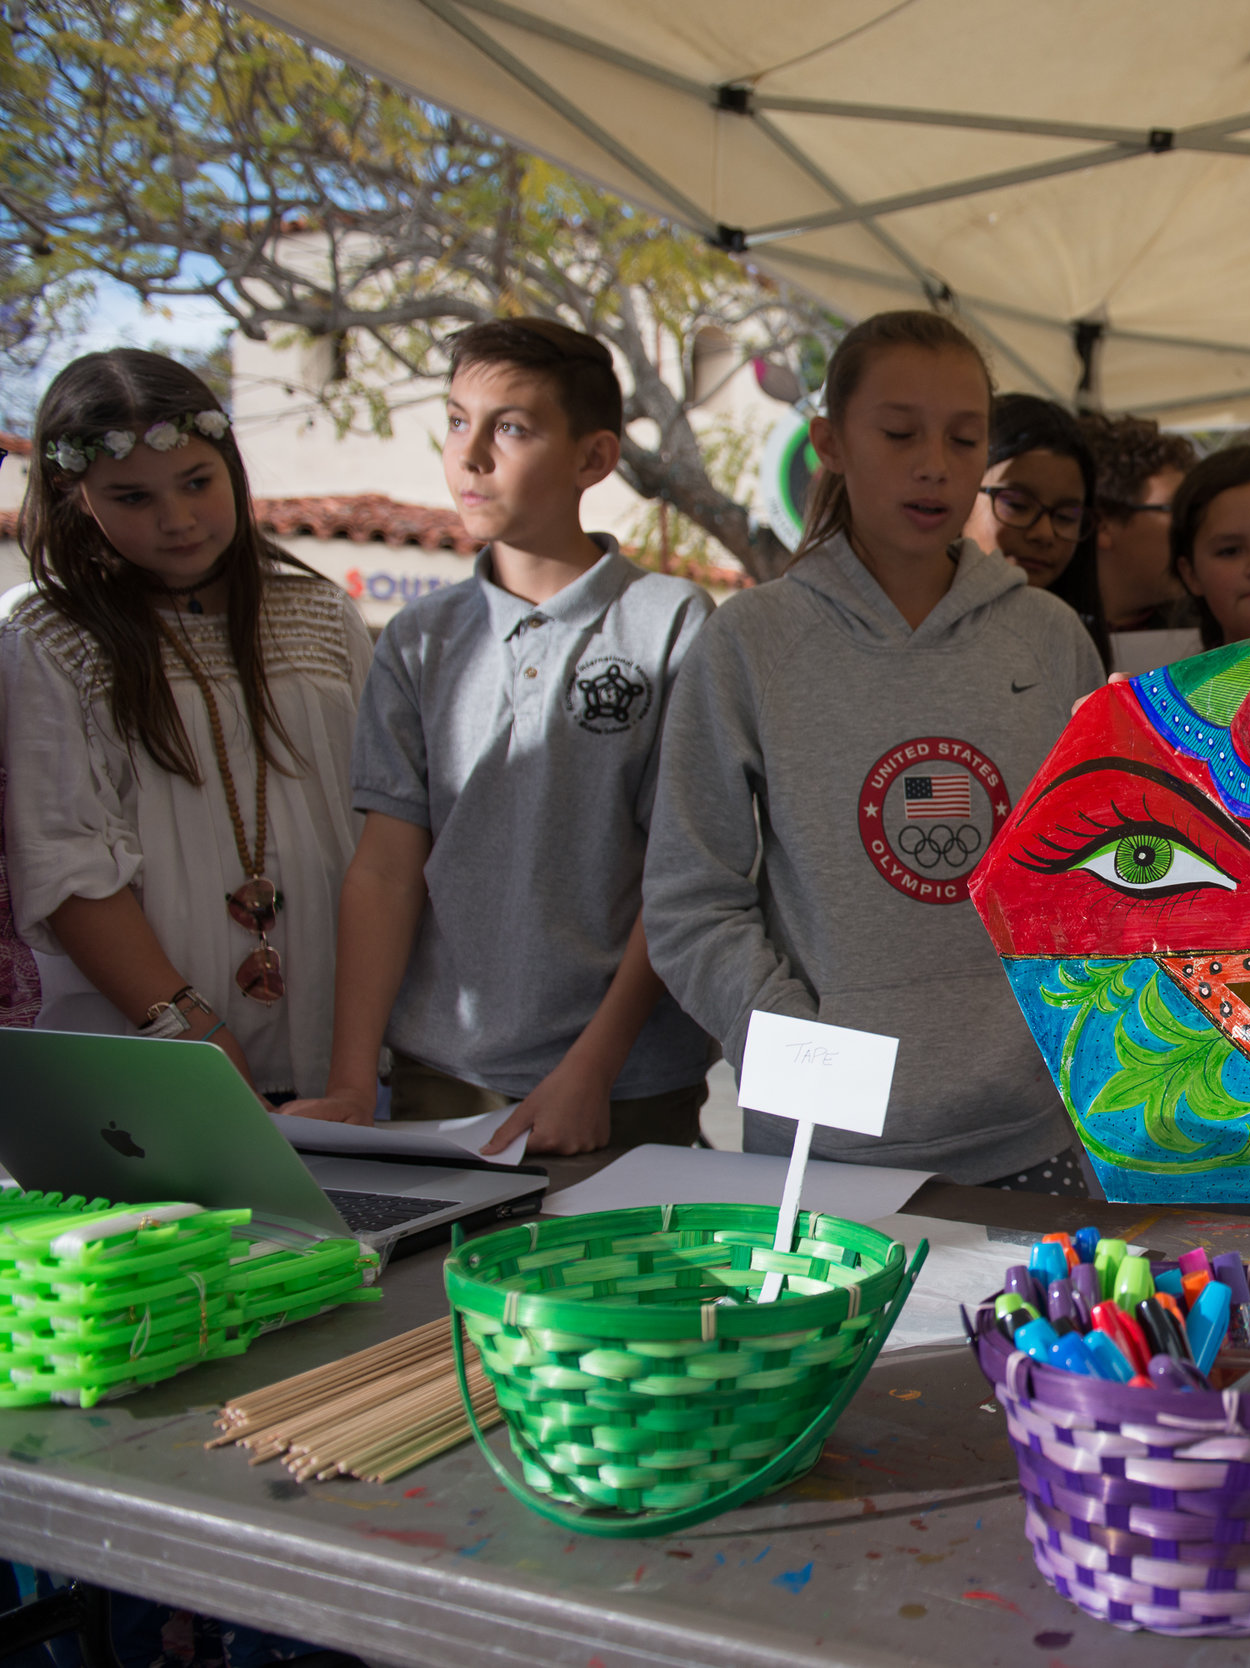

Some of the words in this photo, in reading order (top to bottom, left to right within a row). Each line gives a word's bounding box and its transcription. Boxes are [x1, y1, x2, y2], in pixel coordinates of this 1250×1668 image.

[344, 568, 453, 600] SOUT
[870, 743, 929, 789] UNITED
[938, 742, 999, 788] STATES
[871, 839, 957, 898] OLYMPIC
[785, 1041, 840, 1066] TAPE
